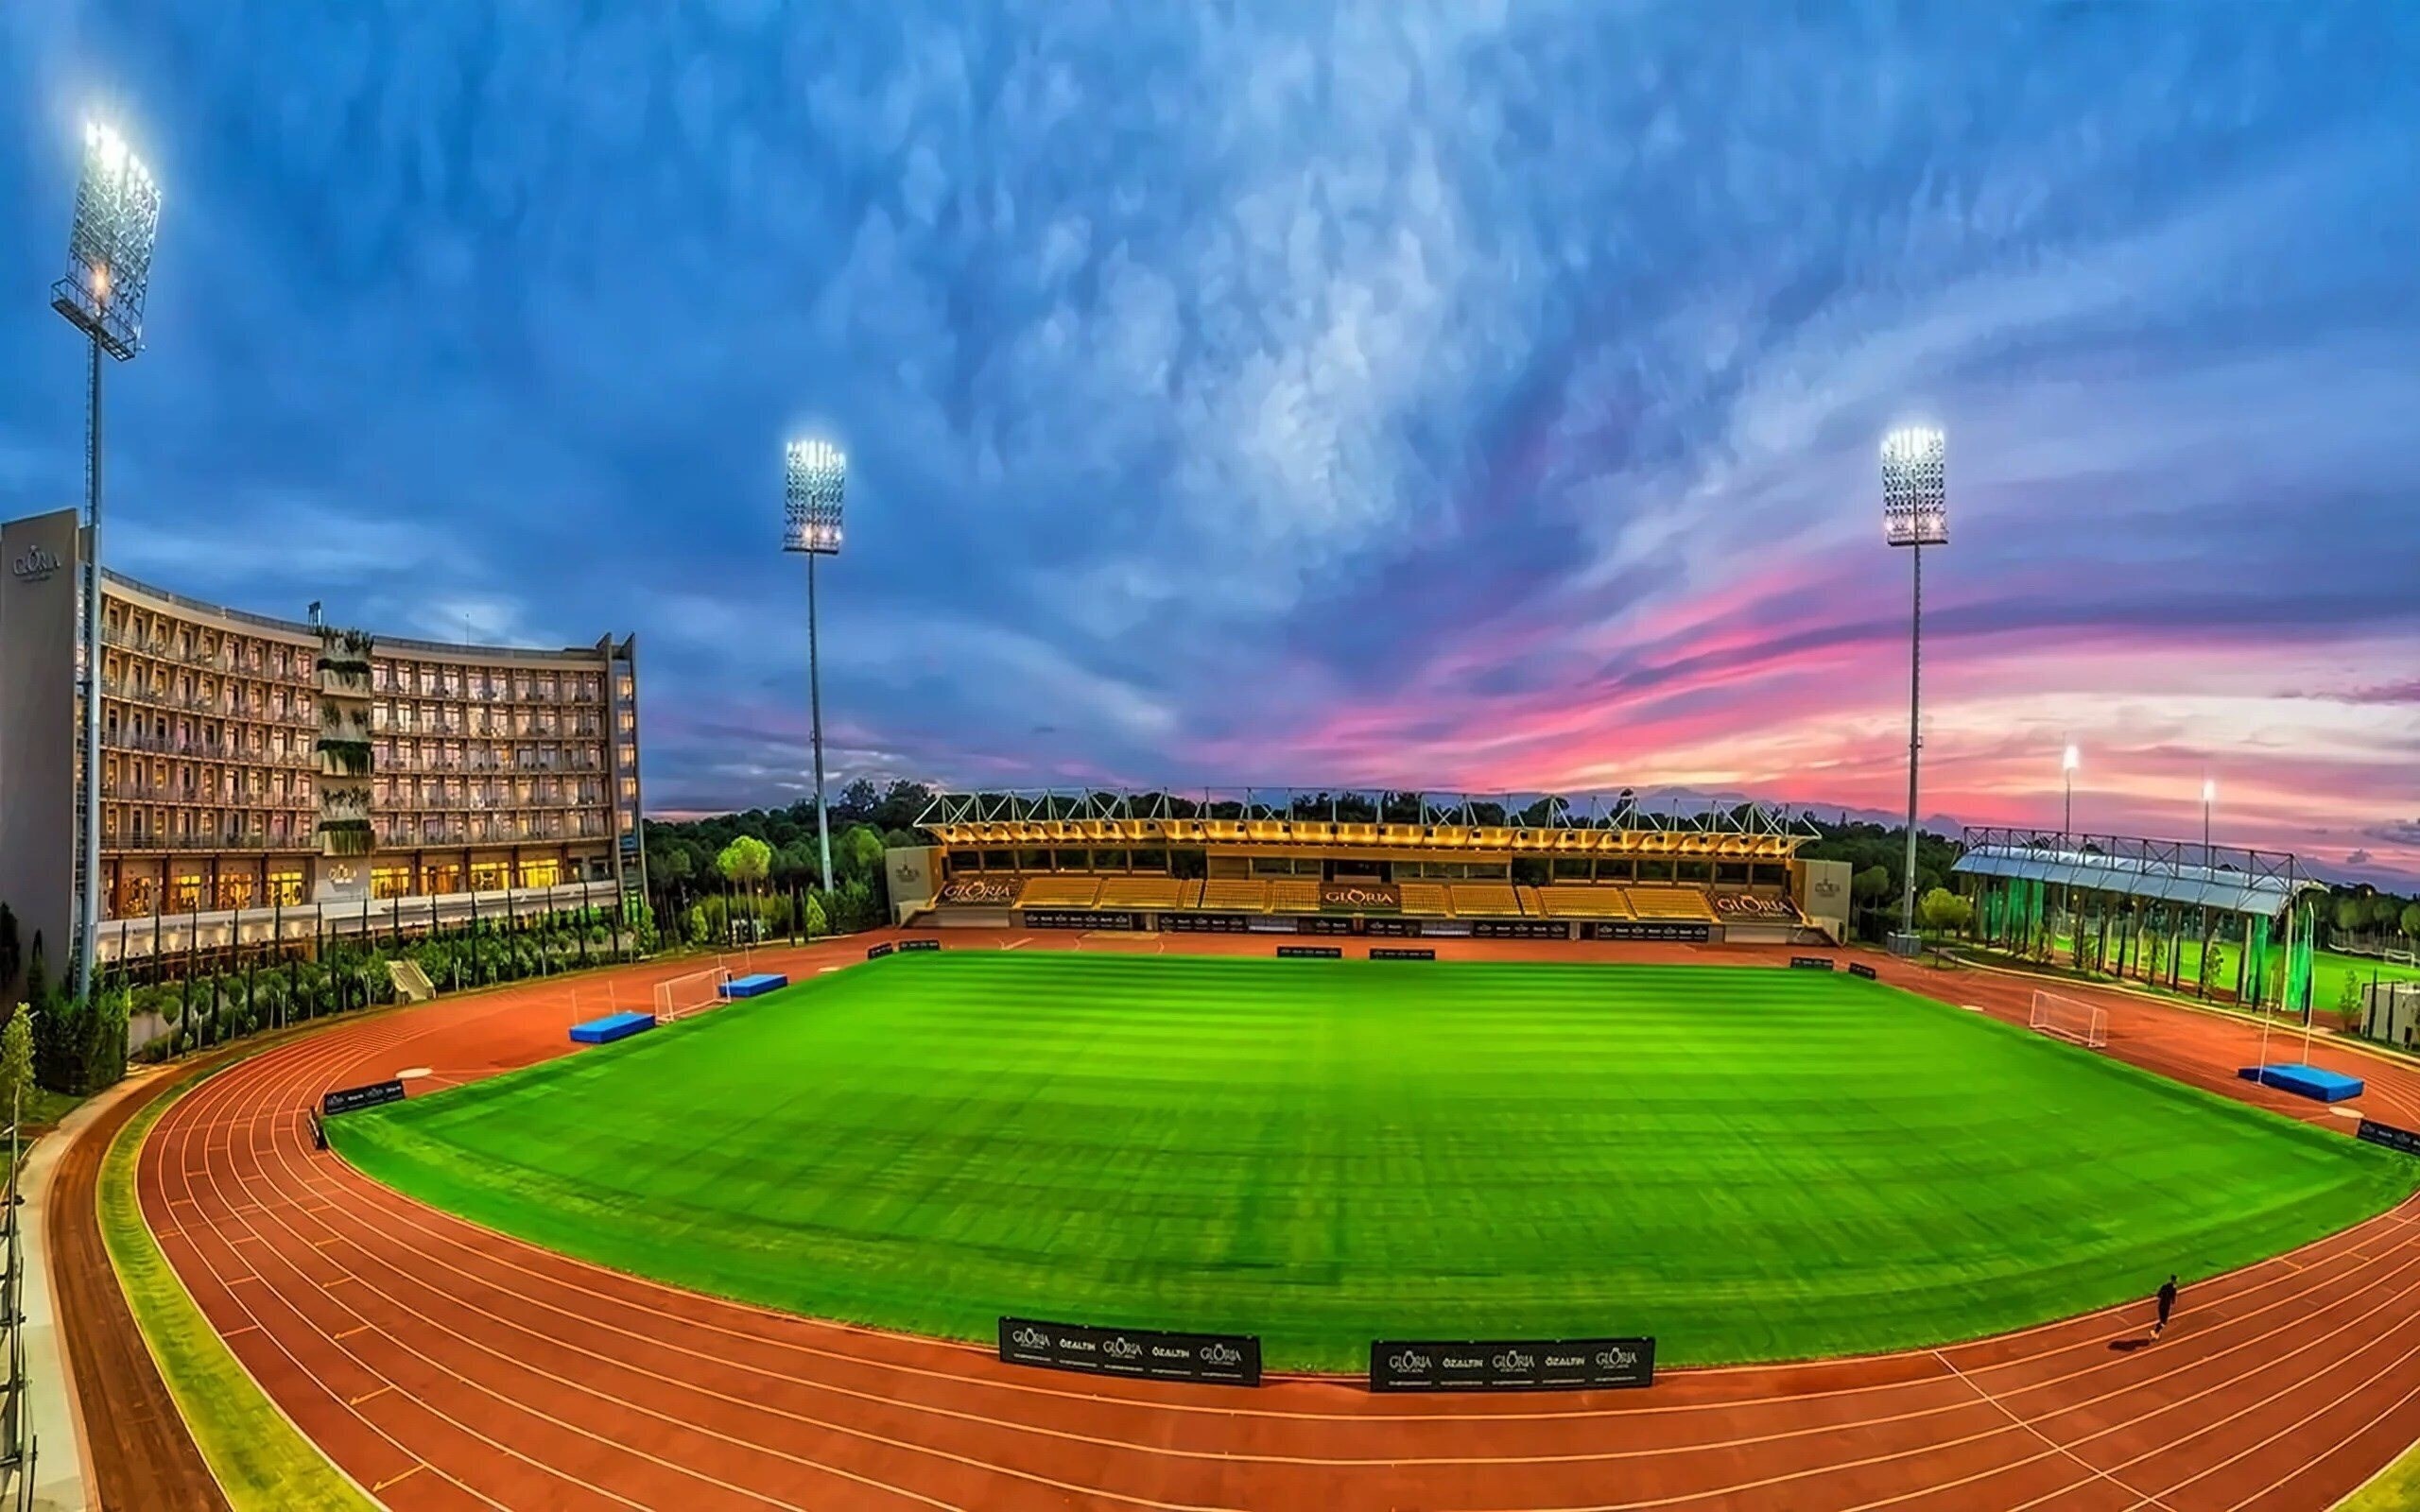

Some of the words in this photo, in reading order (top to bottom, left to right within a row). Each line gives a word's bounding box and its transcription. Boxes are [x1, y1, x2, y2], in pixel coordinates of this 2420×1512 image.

[944, 880, 1010, 899] GLORIA
[1325, 889, 1393, 904] GLORIA
[1717, 895, 1794, 914] GLORIA
[1200, 1343, 1241, 1361] GLORIA
[1389, 1349, 1432, 1369] GLORIA
[1492, 1349, 1535, 1368] GLORIA
[1596, 1347, 1636, 1365] GLORIA
